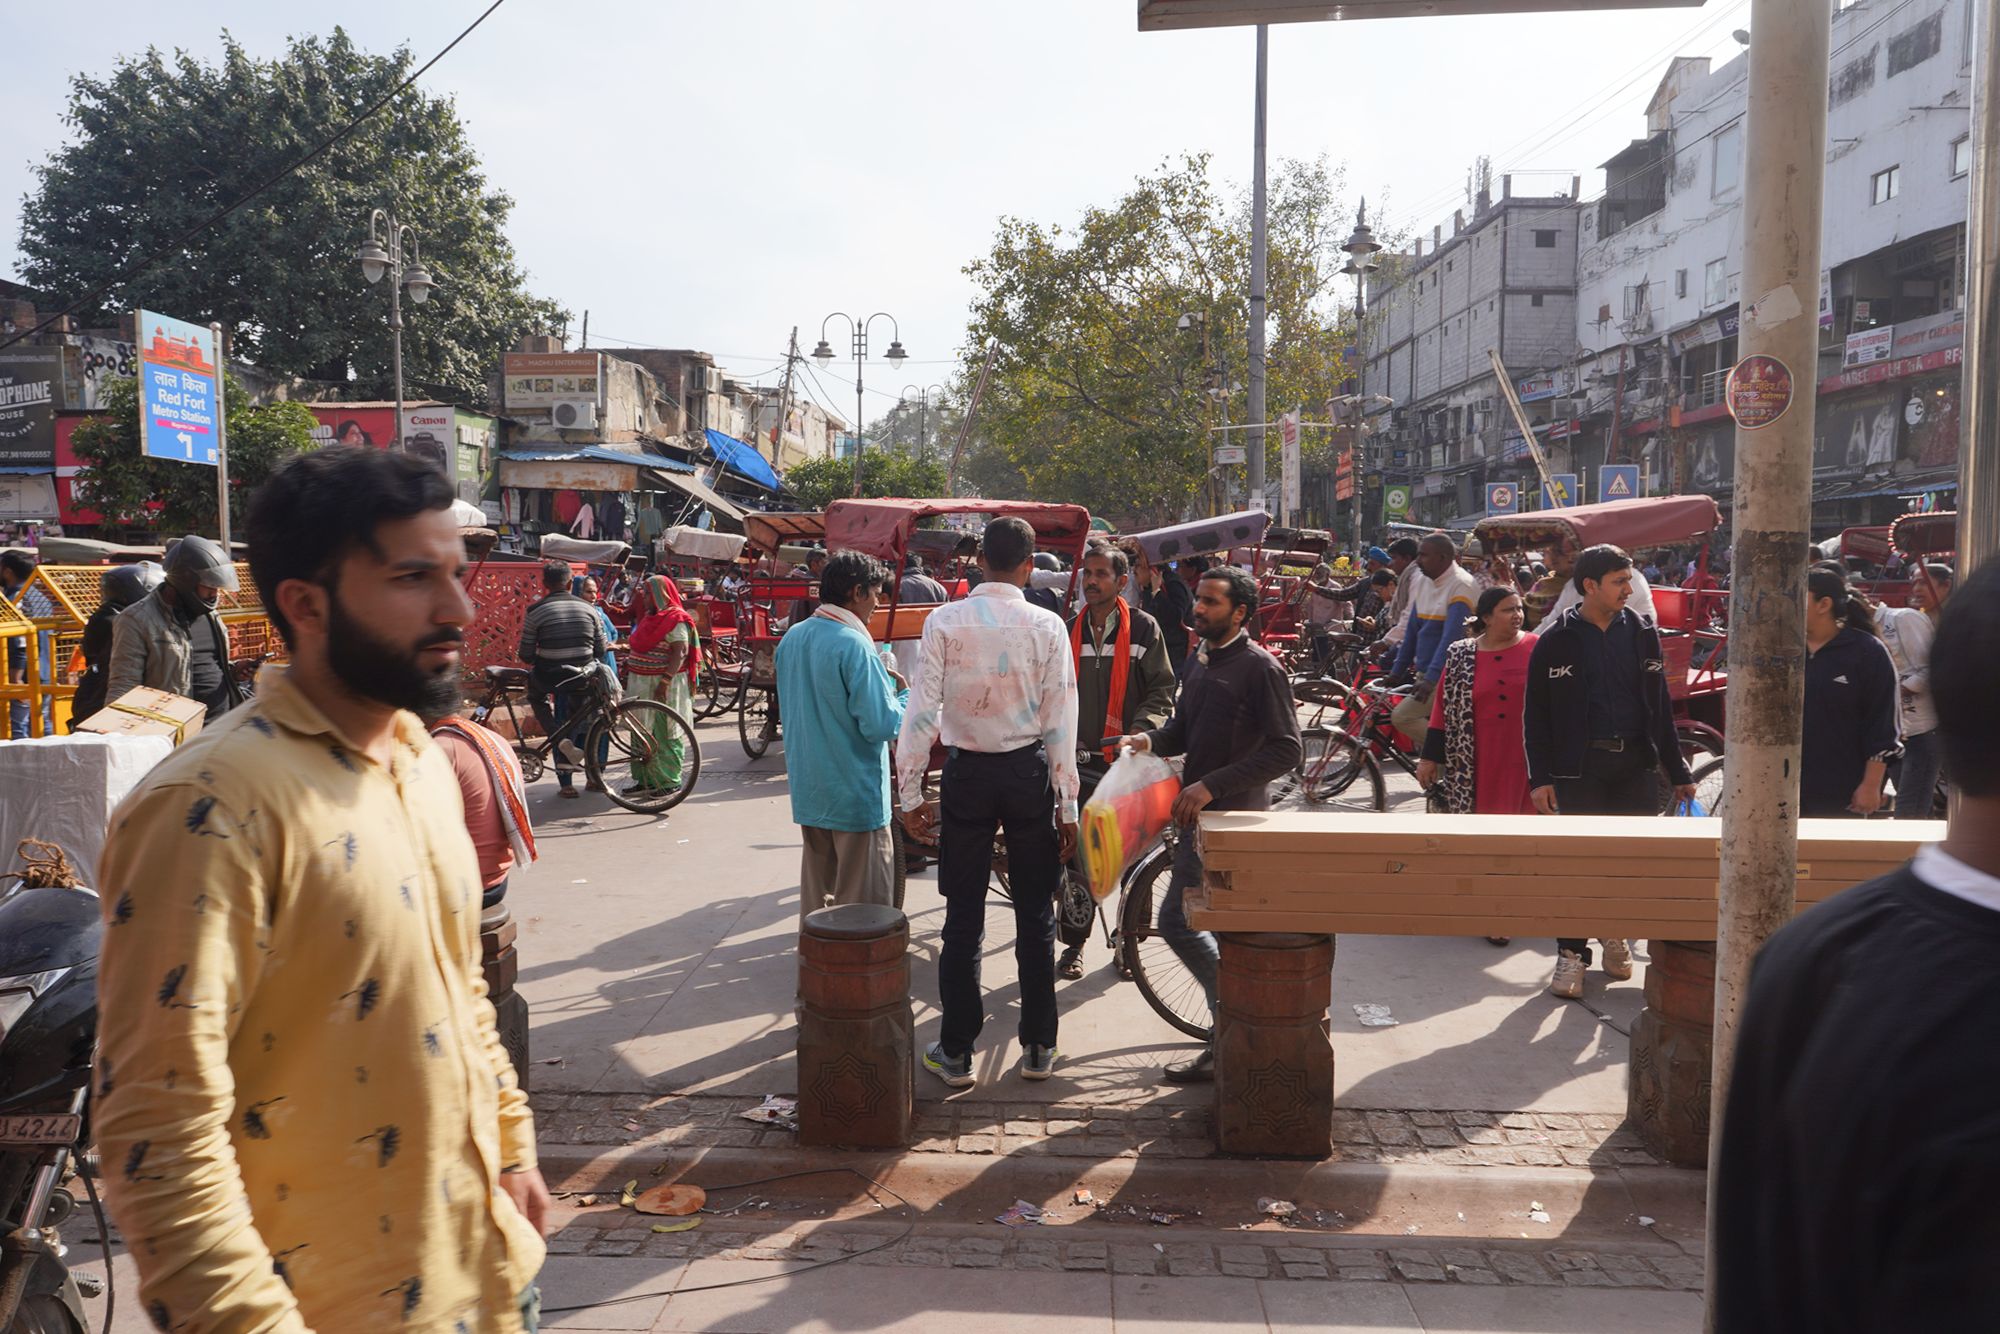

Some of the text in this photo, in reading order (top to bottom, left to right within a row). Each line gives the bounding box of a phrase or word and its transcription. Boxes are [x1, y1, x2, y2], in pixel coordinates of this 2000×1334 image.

[153, 371, 207, 395] लाल किला
[158, 388, 207, 411] Red Fort
[152, 403, 212, 425] Metro Station
[411, 415, 446, 425] Canon
